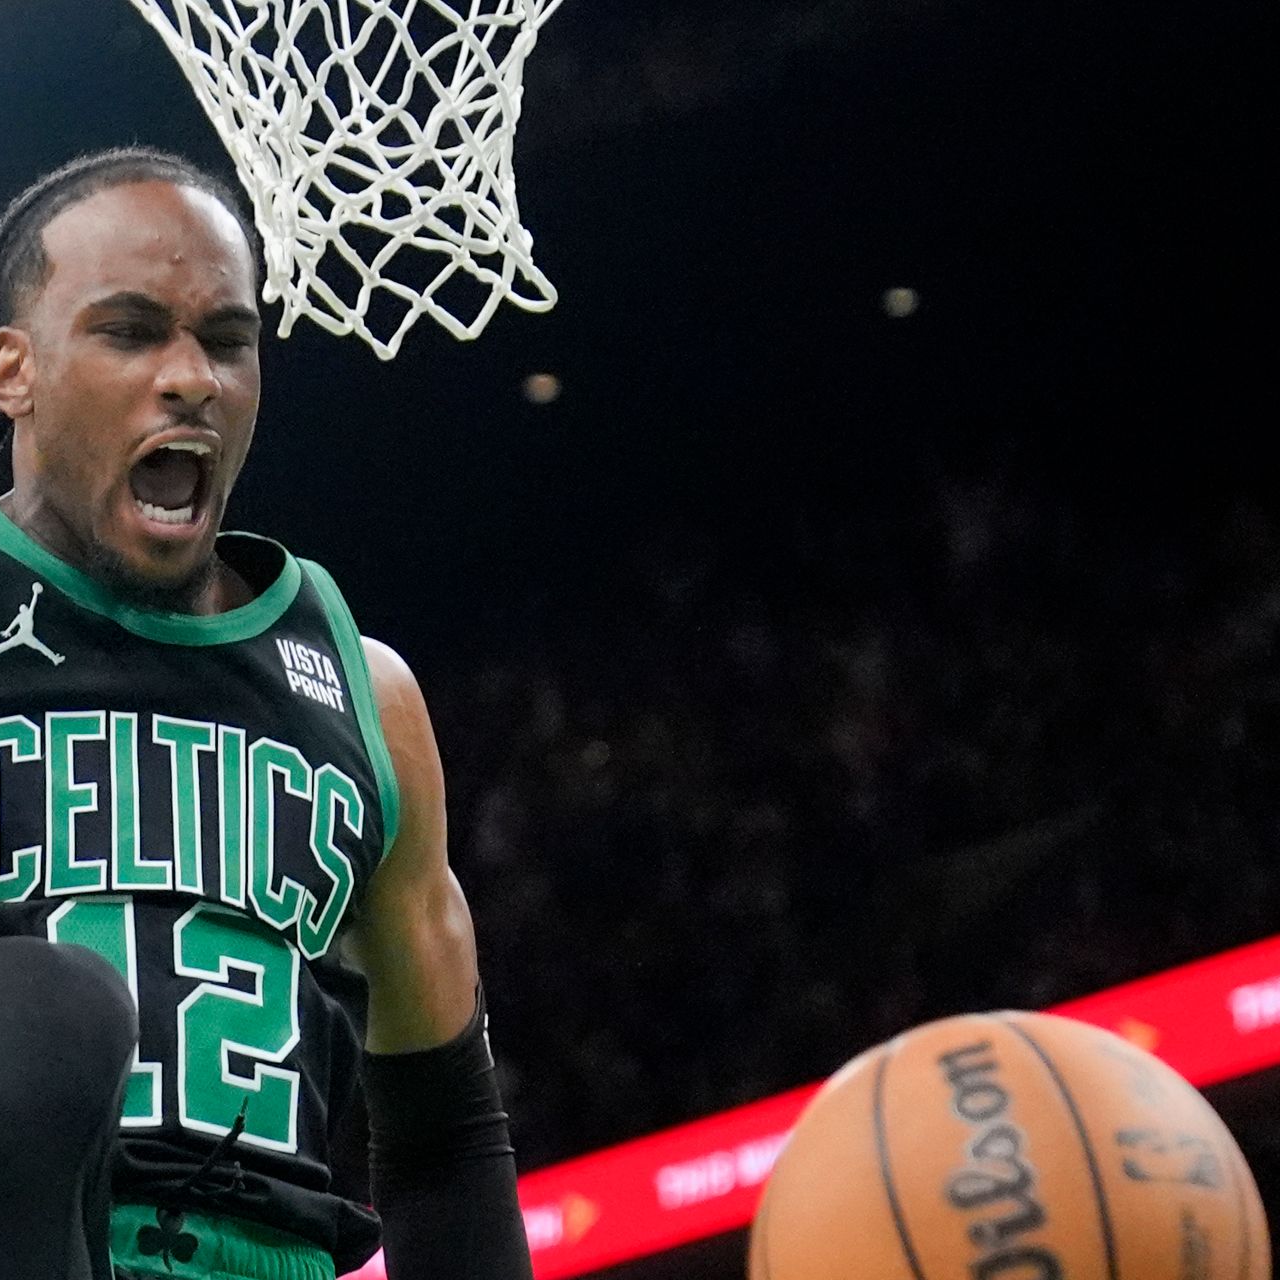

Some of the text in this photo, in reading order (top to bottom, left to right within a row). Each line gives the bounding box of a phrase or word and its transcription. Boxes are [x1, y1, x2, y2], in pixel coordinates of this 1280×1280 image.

[276, 638, 341, 690] VISTA
[285, 669, 345, 713] PRINT
[47, 895, 301, 1154] 12
